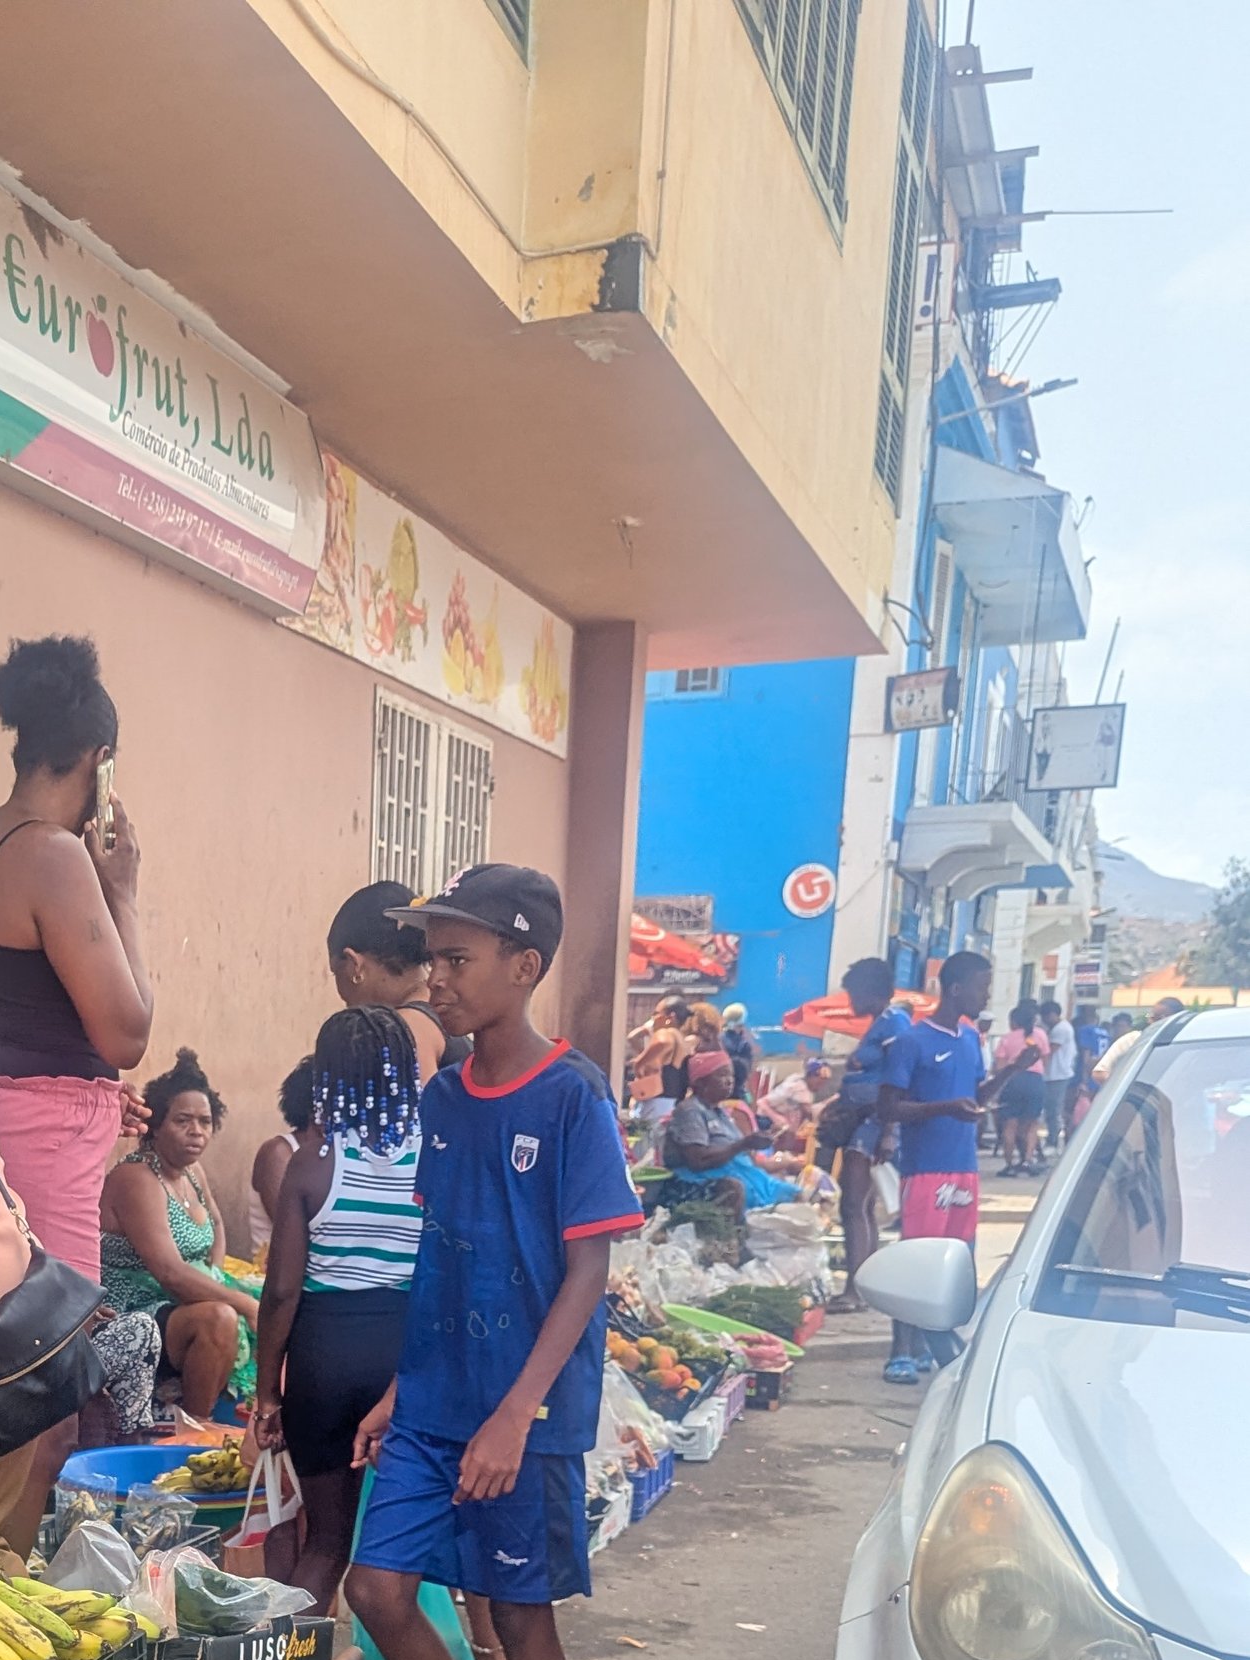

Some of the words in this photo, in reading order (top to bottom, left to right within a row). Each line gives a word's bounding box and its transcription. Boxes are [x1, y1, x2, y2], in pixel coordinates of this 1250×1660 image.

[122, 410, 167, 459] Comércio
[168, 440, 181, 468] de
[181, 448, 222, 494] Produtos
[222, 474, 270, 521] Alimentares
[207, 372, 275, 482] Lda
